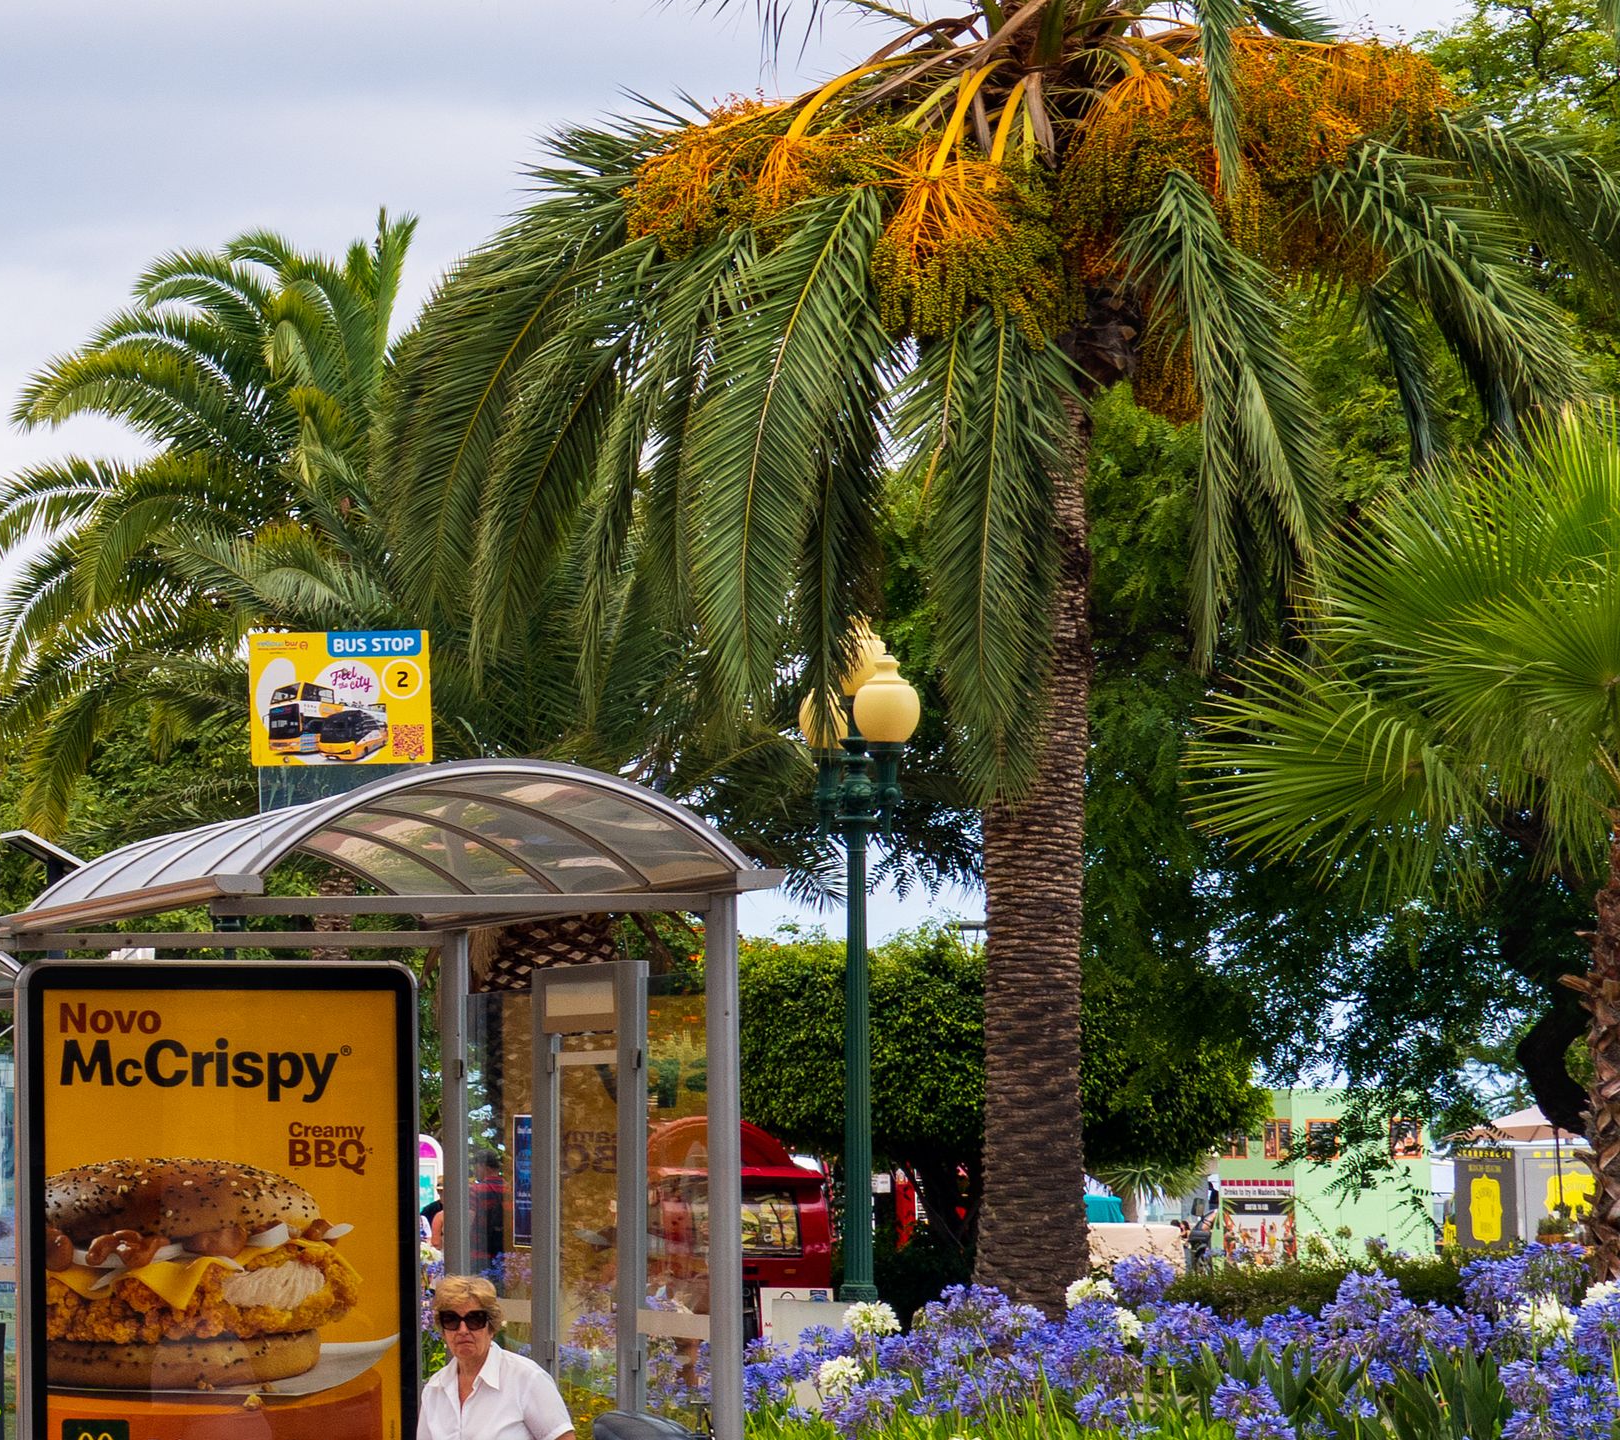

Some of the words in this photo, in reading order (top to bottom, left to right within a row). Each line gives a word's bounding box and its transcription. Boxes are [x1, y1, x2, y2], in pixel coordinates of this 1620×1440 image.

[333, 638, 367, 653] BUS
[372, 637, 415, 652] STOP
[330, 666, 357, 686] Feel
[350, 676, 373, 693] city
[397, 671, 409, 688] 2
[59, 1002, 162, 1034] Novo
[288, 1121, 365, 1141] Creamy
[288, 1139, 367, 1175] BBQ
